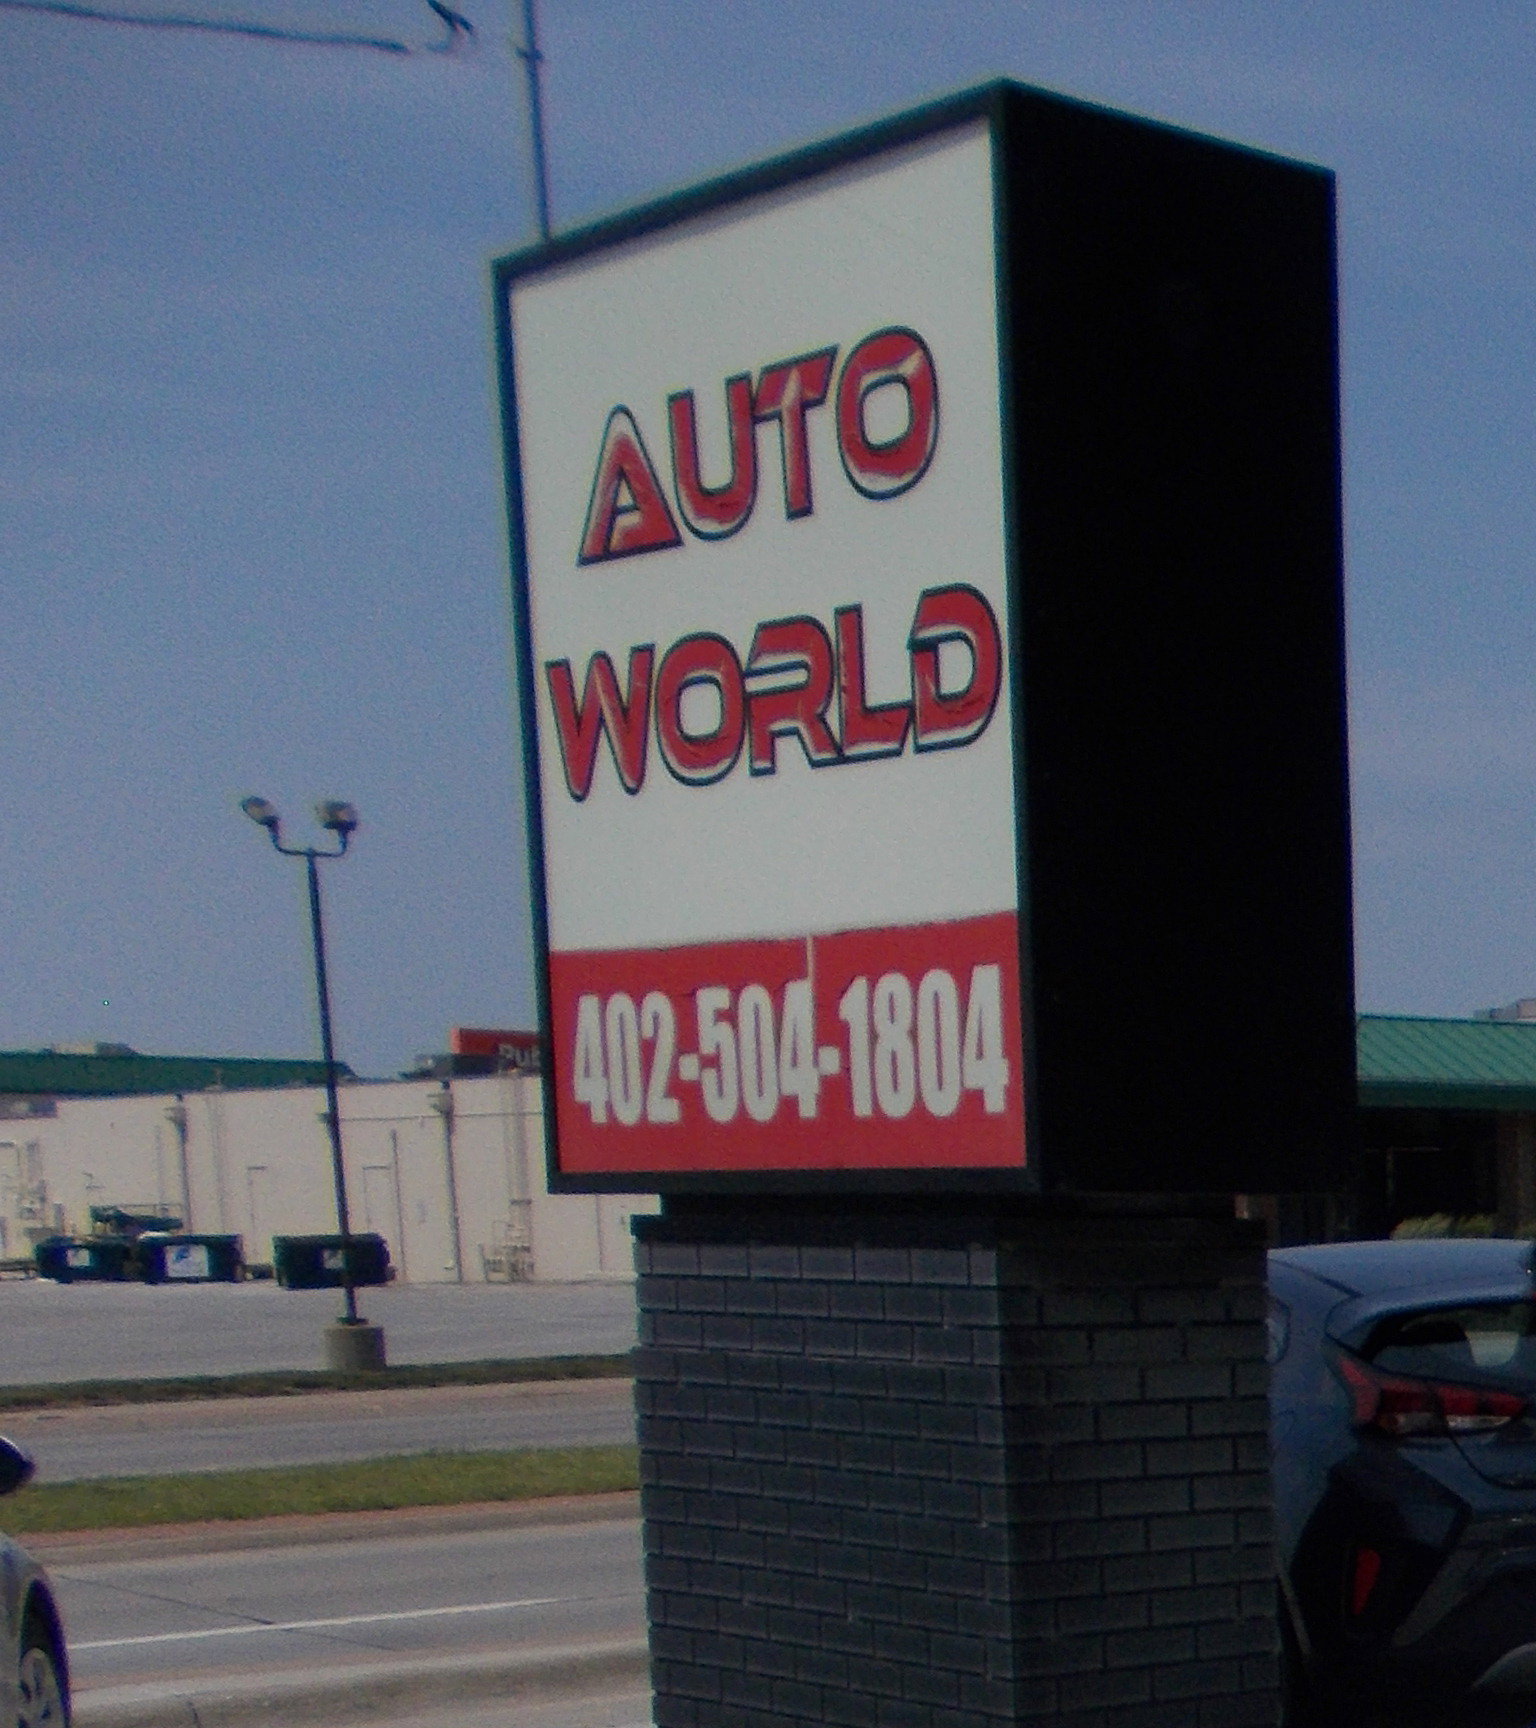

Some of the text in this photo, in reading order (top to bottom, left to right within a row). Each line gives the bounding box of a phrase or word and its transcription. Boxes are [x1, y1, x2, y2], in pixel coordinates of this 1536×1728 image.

[576, 324, 940, 568] AUTO
[544, 582, 1004, 802] WORLD
[572, 963, 1010, 1127] 402-504-1804
